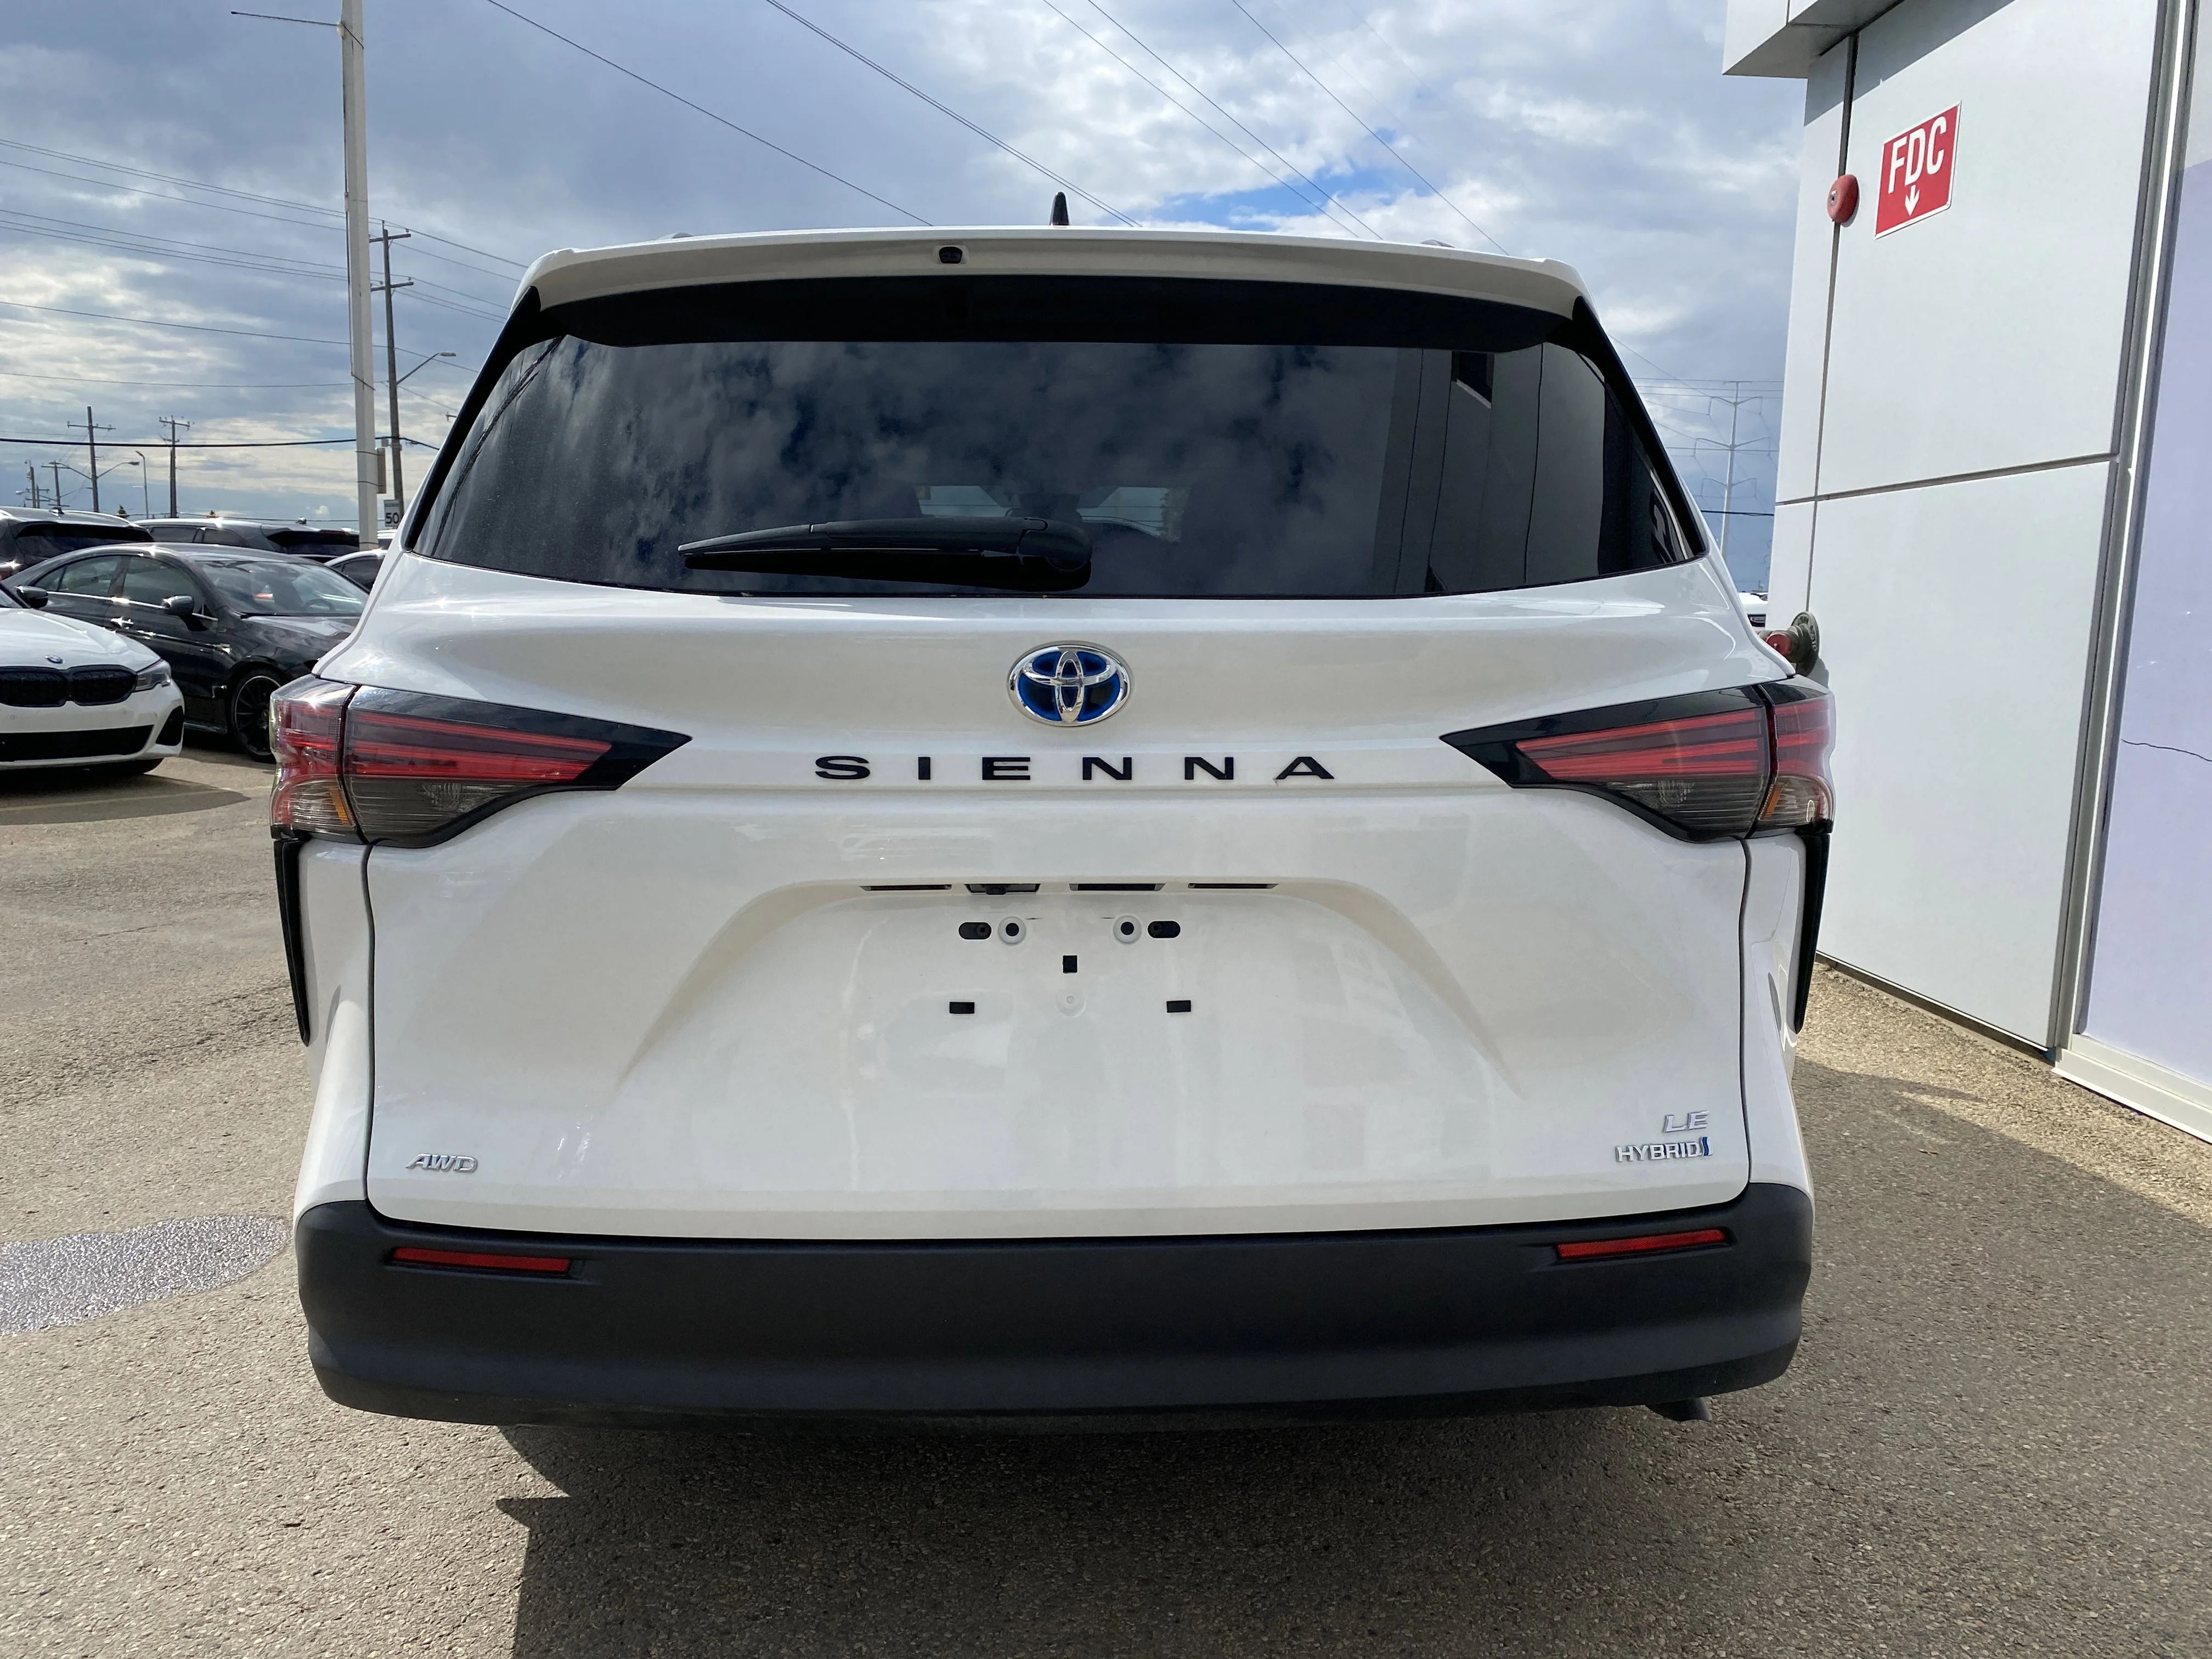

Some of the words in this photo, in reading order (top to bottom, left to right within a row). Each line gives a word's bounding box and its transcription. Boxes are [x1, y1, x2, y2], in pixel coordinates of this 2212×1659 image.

[1888, 116, 1947, 194] FDC
[385, 512, 399, 524] 50
[814, 755, 1335, 781] SIENNA
[1663, 1110, 1709, 1133] LE
[405, 1153, 478, 1172] AWD
[1615, 1141, 1702, 1162] HYBRID
